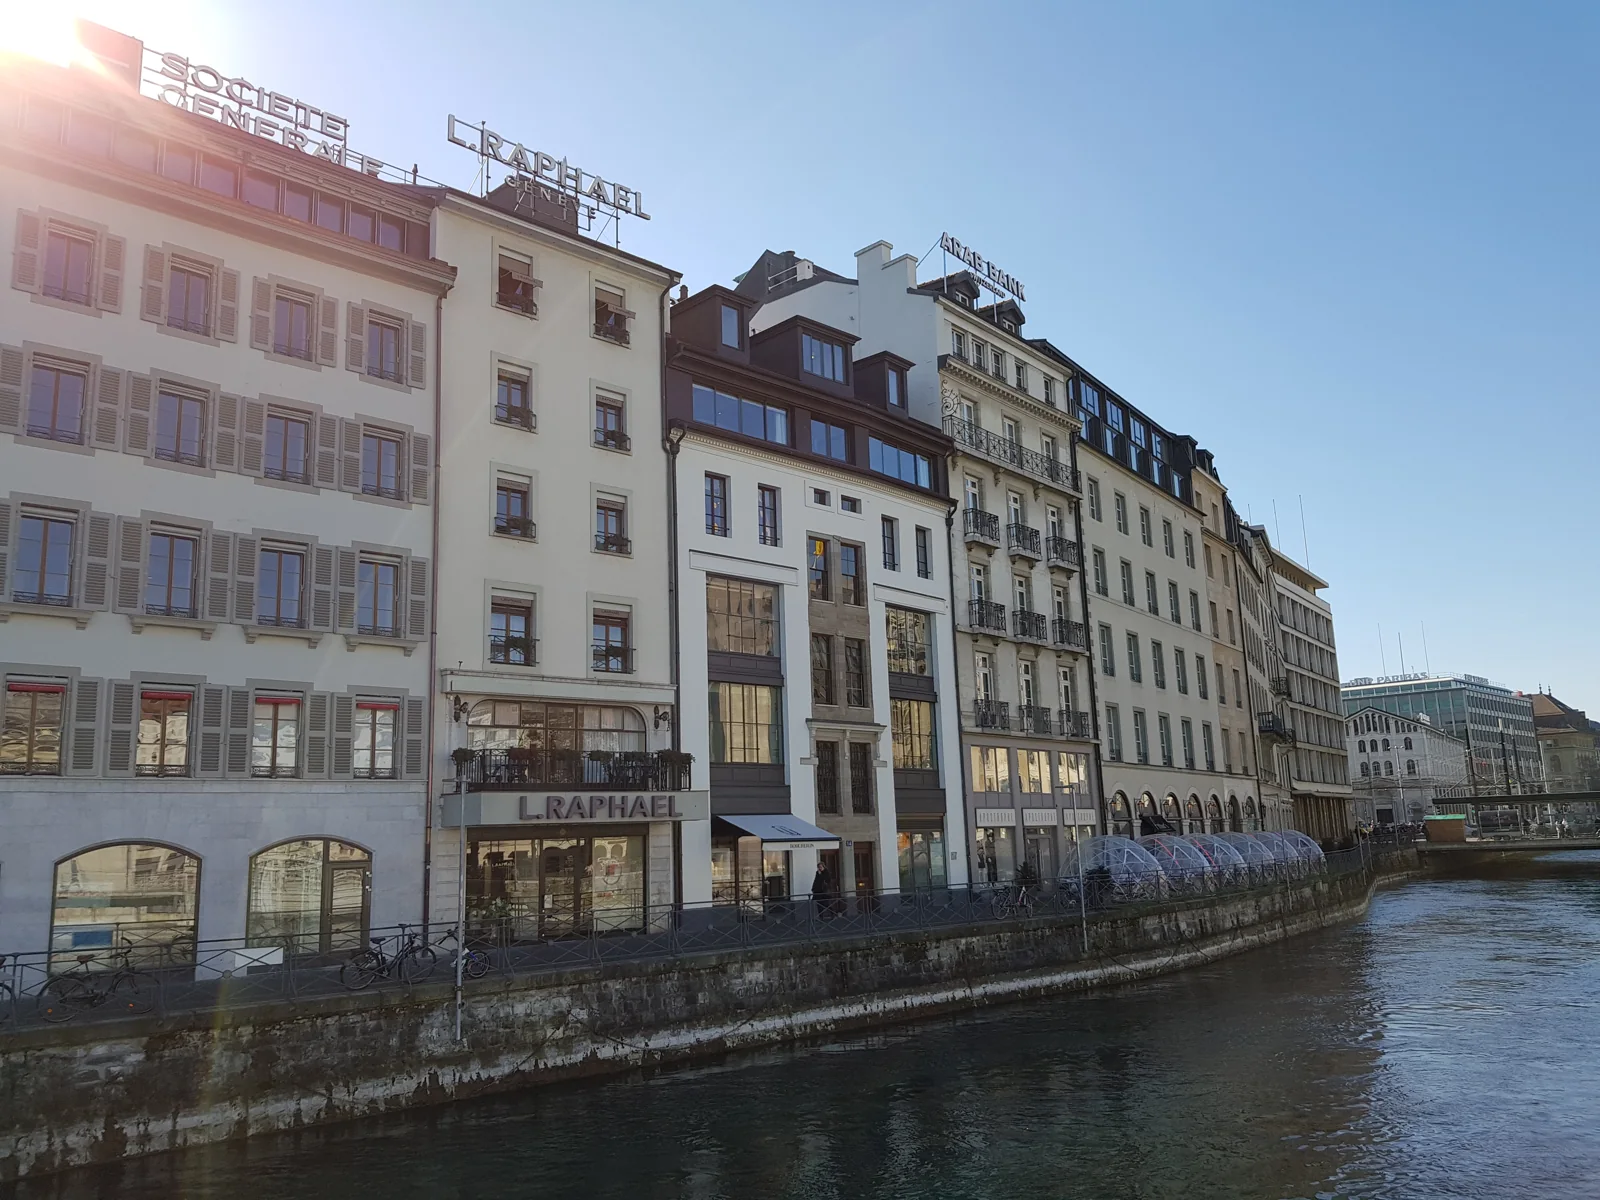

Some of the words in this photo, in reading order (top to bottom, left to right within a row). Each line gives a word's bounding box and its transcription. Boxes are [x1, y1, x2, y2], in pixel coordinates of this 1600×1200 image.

[161, 52, 347, 141] SOCIETE
[447, 114, 651, 221] L.RAPHAEL
[940, 232, 984, 273] ARAB
[987, 261, 1026, 302] BANK
[1376, 671, 1428, 684] PARIBAS
[519, 795, 683, 820] L.RAPHAEL
